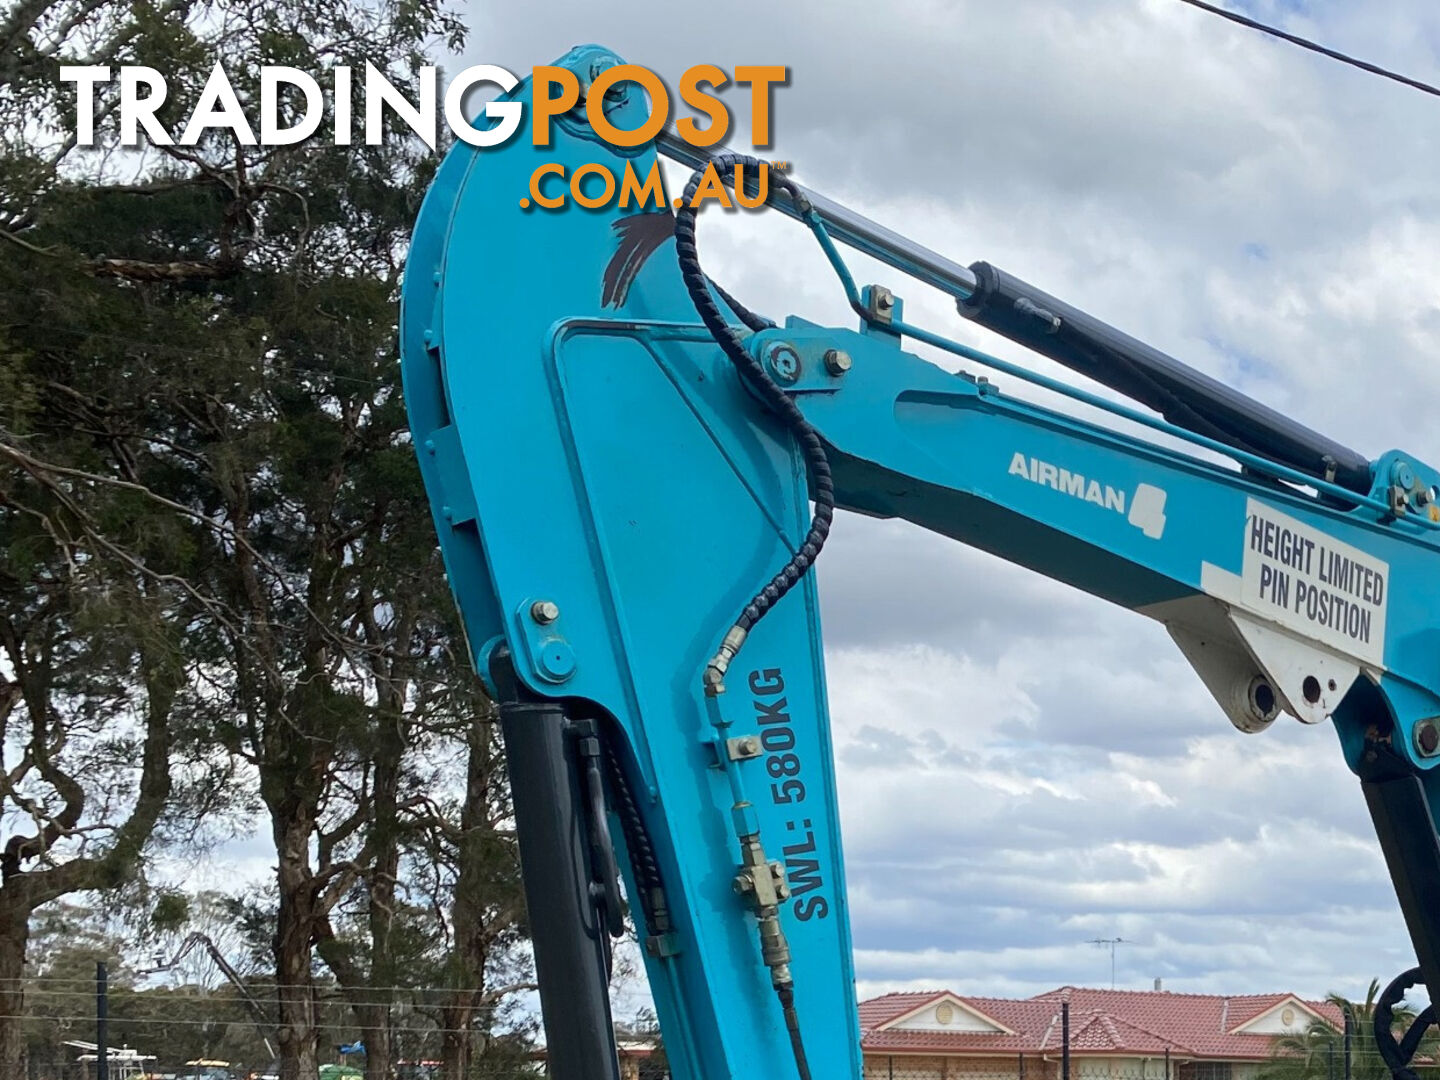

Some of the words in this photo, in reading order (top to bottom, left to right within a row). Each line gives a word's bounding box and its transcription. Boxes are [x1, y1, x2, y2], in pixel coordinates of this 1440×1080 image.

[1008, 452, 1126, 514] AIRMAN
[1250, 514, 1315, 575] HEIGHT
[1319, 546, 1384, 607] LIMITED
[1259, 563, 1290, 609] PIN
[1295, 579, 1371, 644] POSITION
[748, 667, 806, 804] 580KG
[782, 818, 829, 922] SWL:
